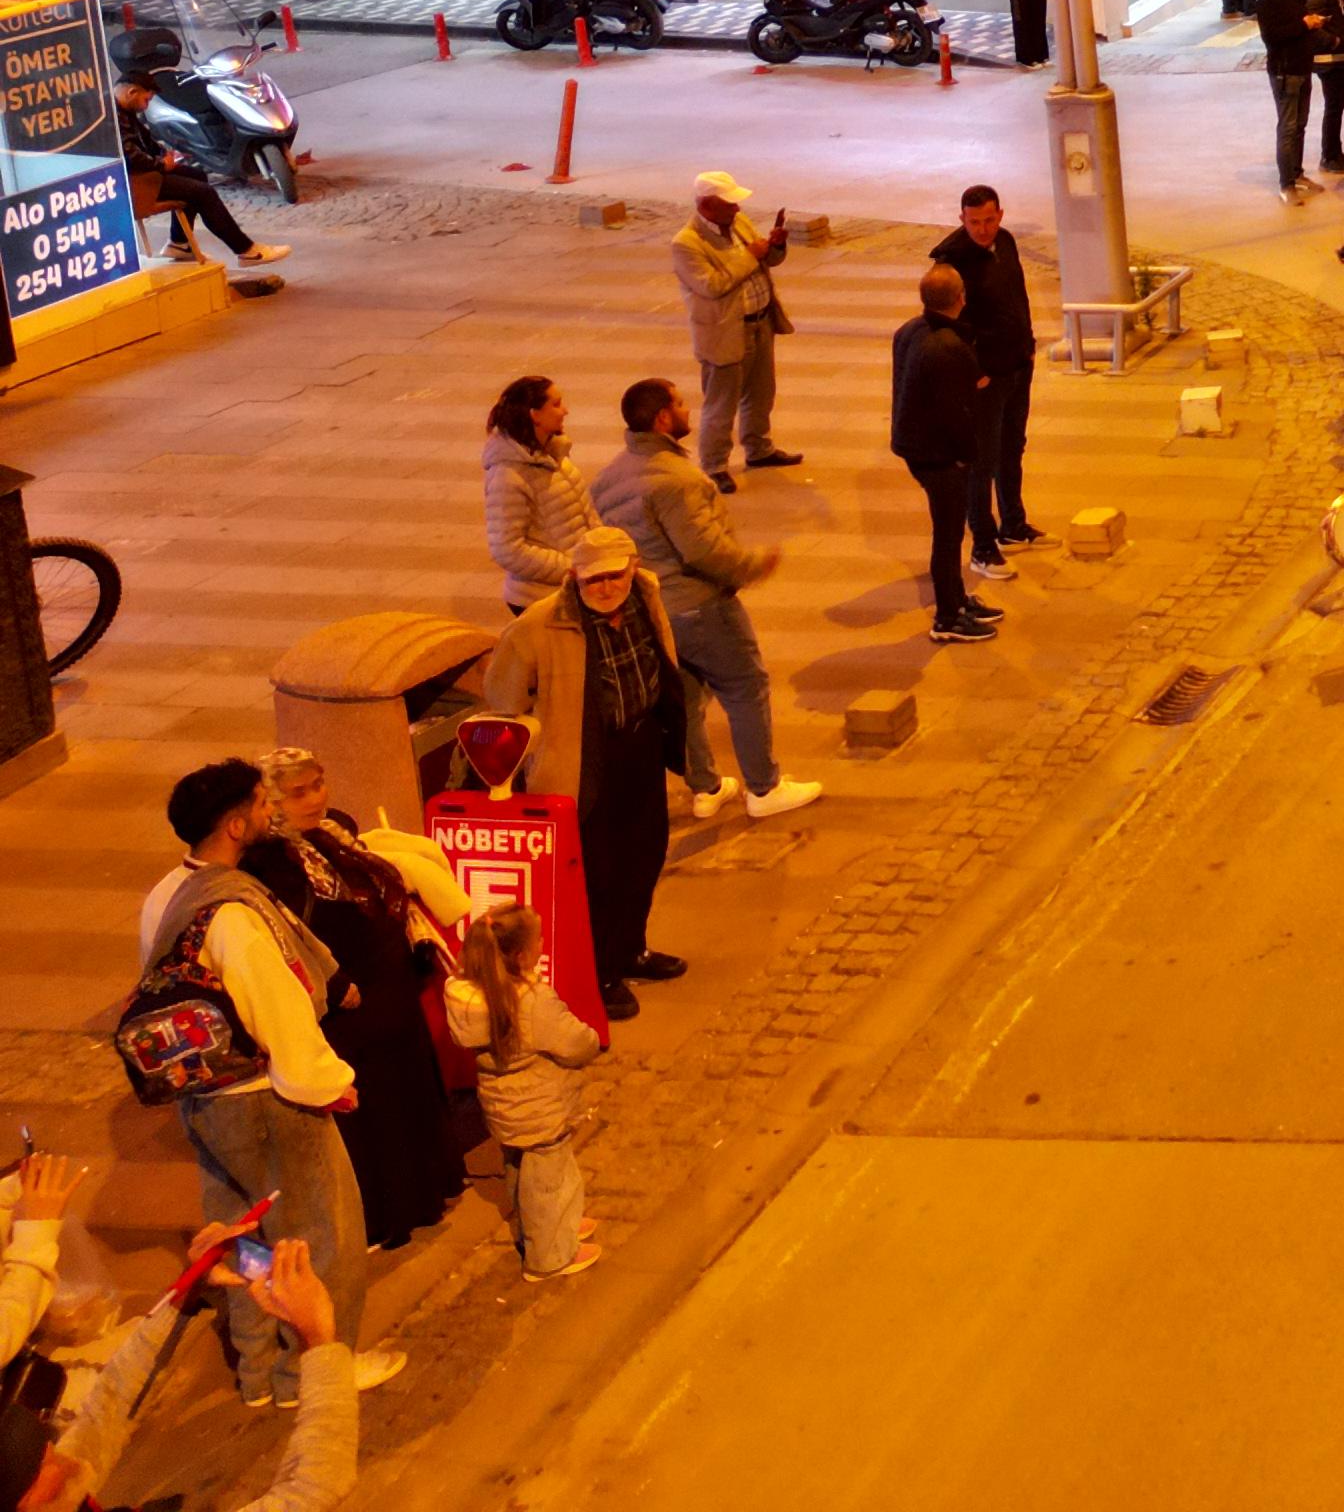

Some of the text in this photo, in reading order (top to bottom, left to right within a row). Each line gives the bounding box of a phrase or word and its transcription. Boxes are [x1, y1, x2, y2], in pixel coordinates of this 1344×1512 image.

[5, 42, 73, 80] ÖMER
[21, 97, 75, 138] YERİ
[4, 175, 117, 235] Alo Paket
[33, 215, 101, 260] 0 544
[16, 240, 126, 302] 254 42 31
[435, 822, 553, 861] NÖBETÇİ
